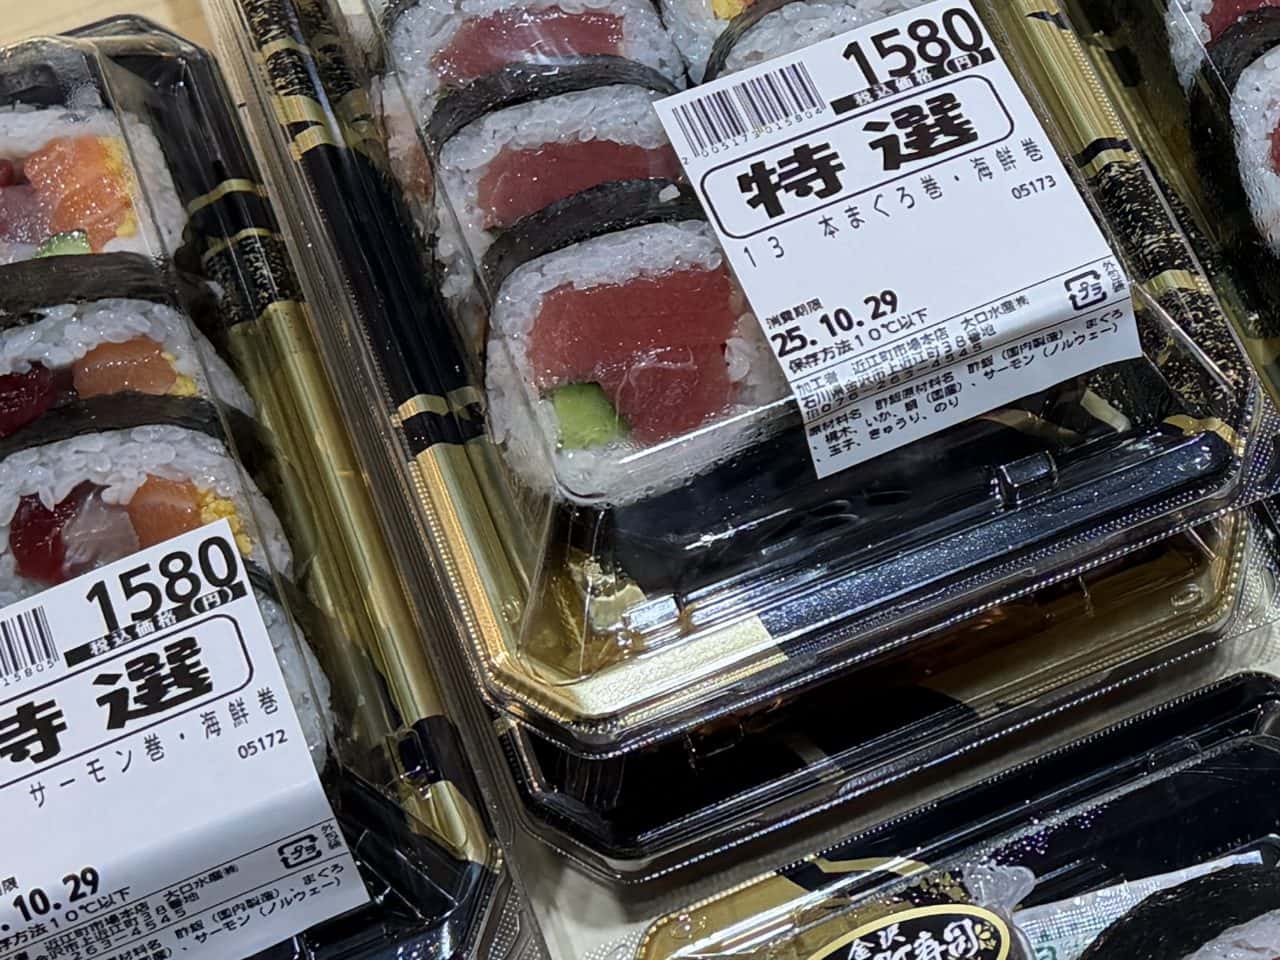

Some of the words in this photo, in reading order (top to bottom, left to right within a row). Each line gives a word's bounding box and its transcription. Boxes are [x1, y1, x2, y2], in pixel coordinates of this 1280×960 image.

[842, 8, 983, 86] 1580
[737, 93, 978, 219] 特選
[1011, 175, 1057, 200] 05173
[743, 235, 785, 268] 13
[1078, 281, 1102, 301] プラ
[765, 297, 824, 330] 消費期限
[789, 308, 928, 374] 保存方法10℃以下
[809, 408, 863, 437] 原材料名
[85, 536, 237, 633] 1580
[29, 687, 279, 808] サーモン巻・海鮮巻
[238, 728, 288, 760] 05172
